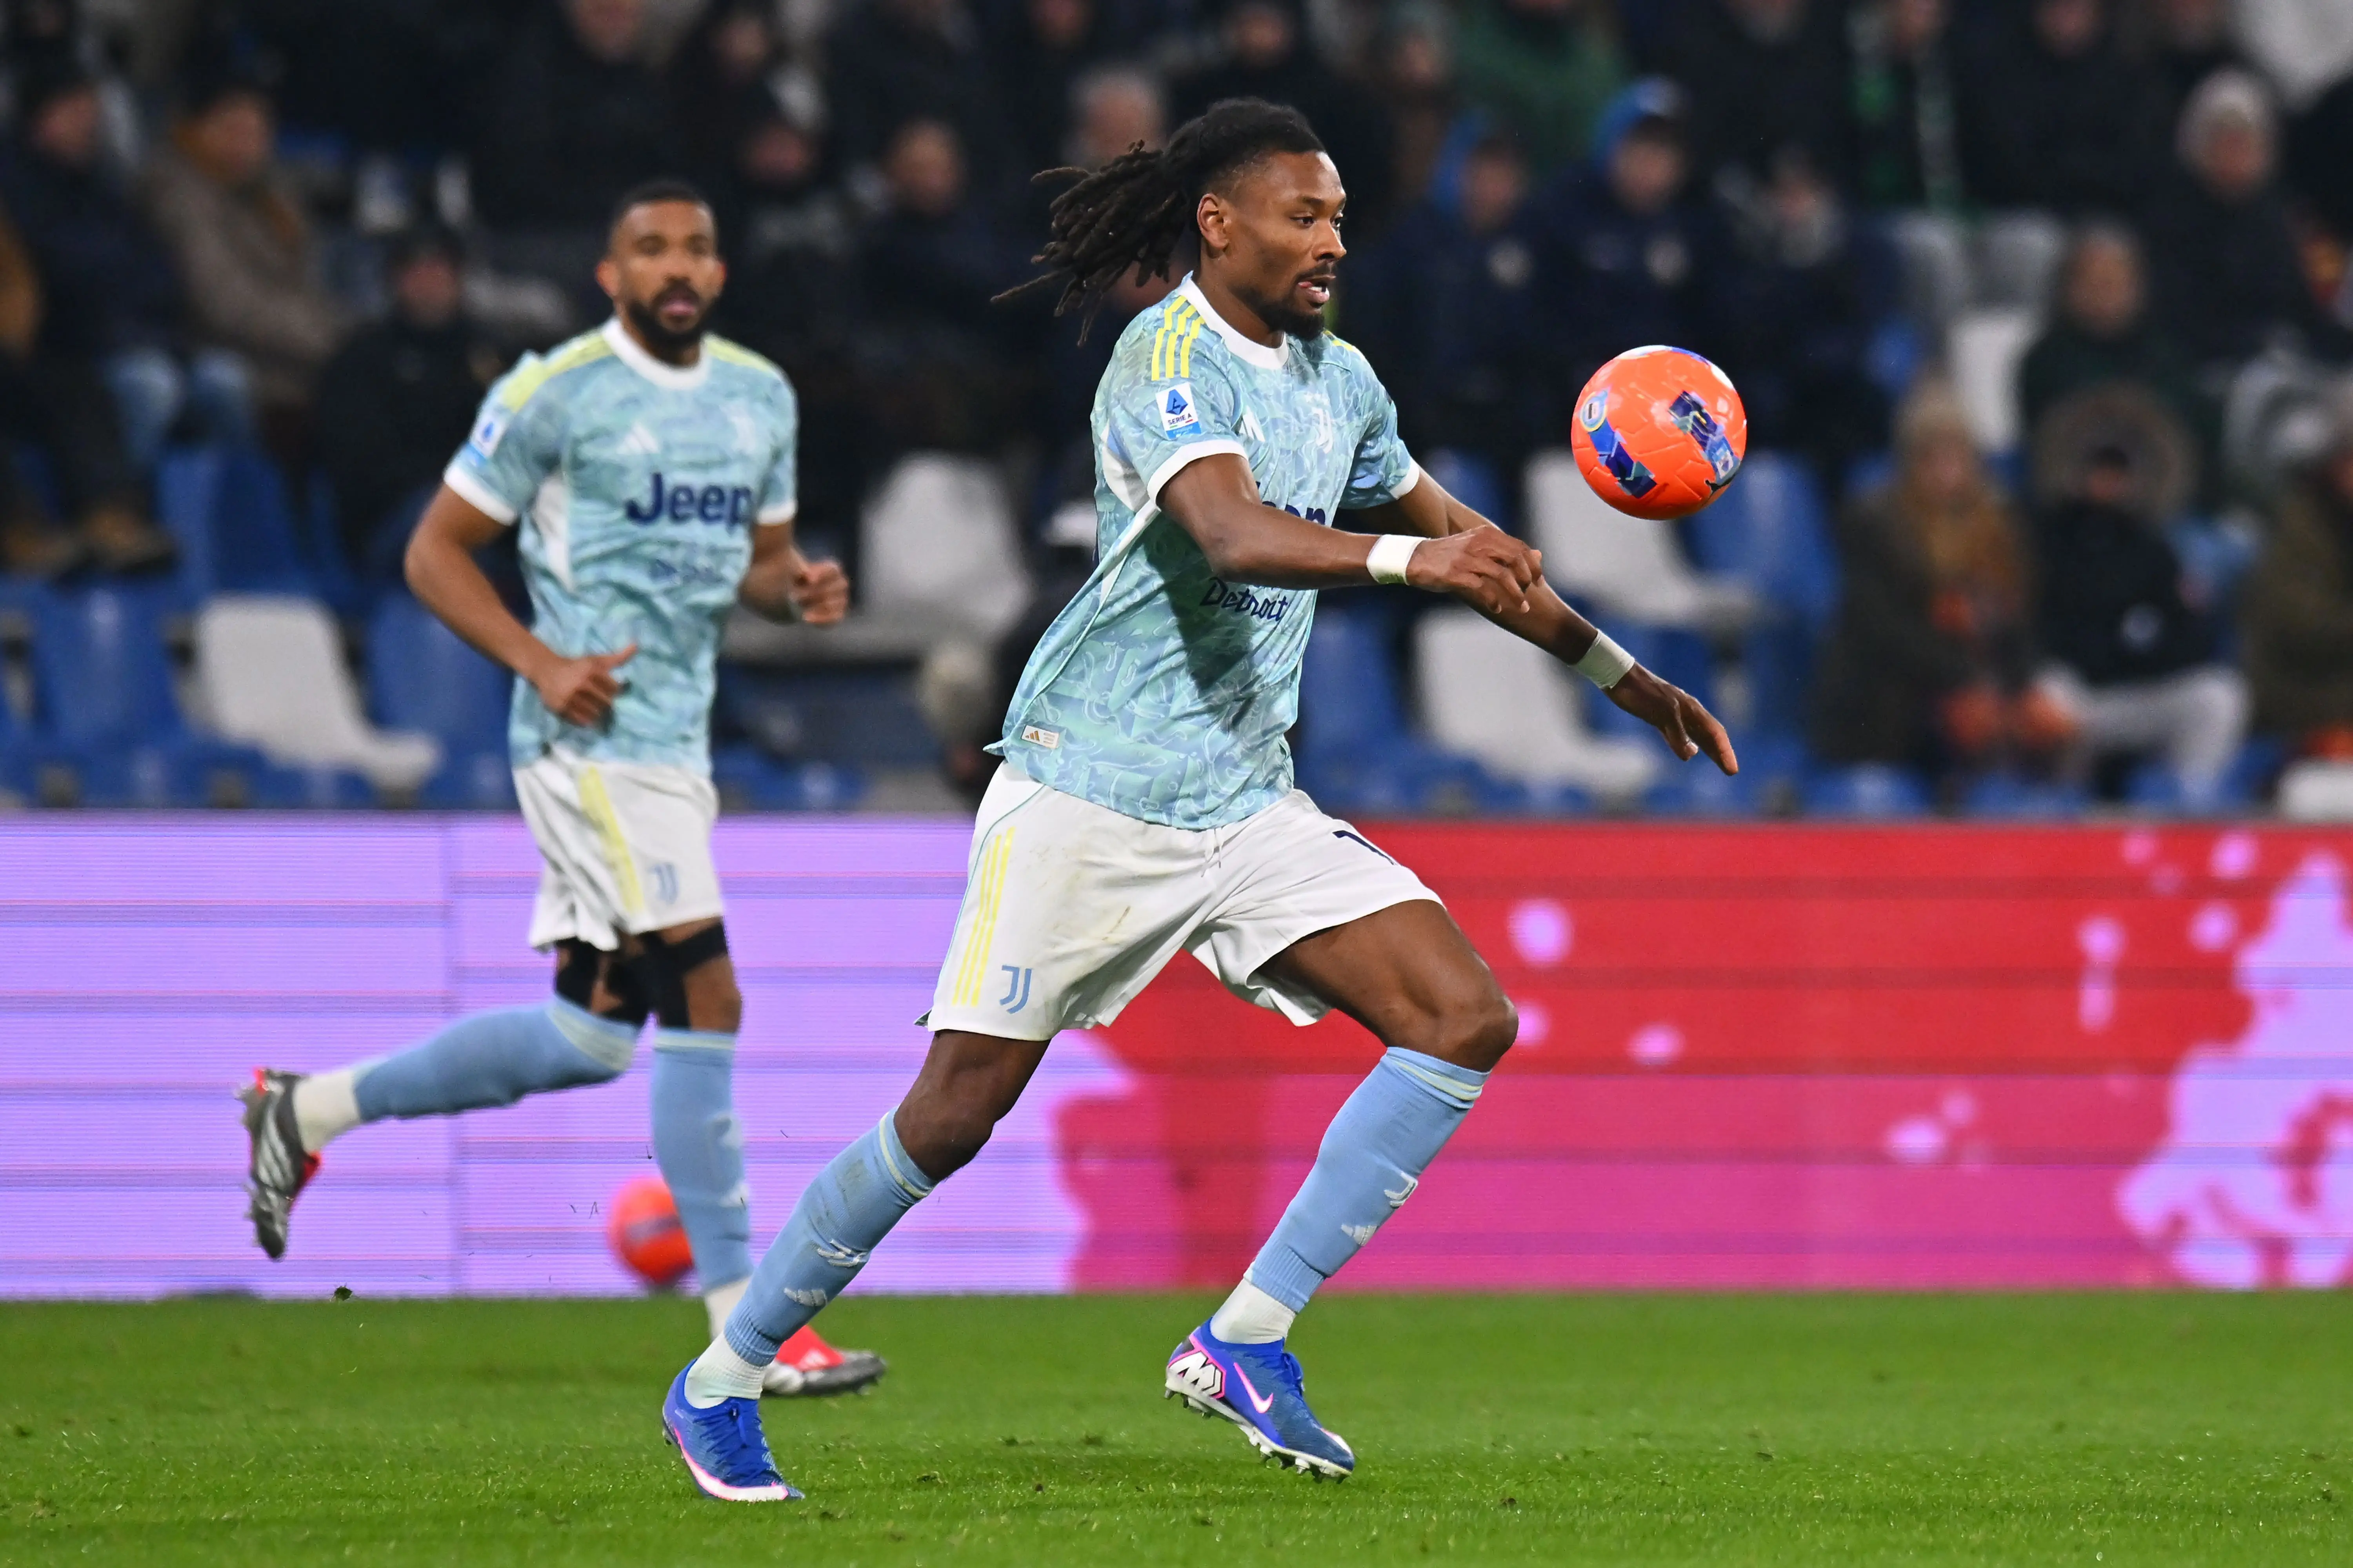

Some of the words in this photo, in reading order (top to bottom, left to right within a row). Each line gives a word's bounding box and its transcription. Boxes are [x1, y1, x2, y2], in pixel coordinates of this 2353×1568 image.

[1168, 414, 1186, 425] SERIE
[624, 472, 752, 536] Jeep
[1199, 576, 1288, 621] Detroit
